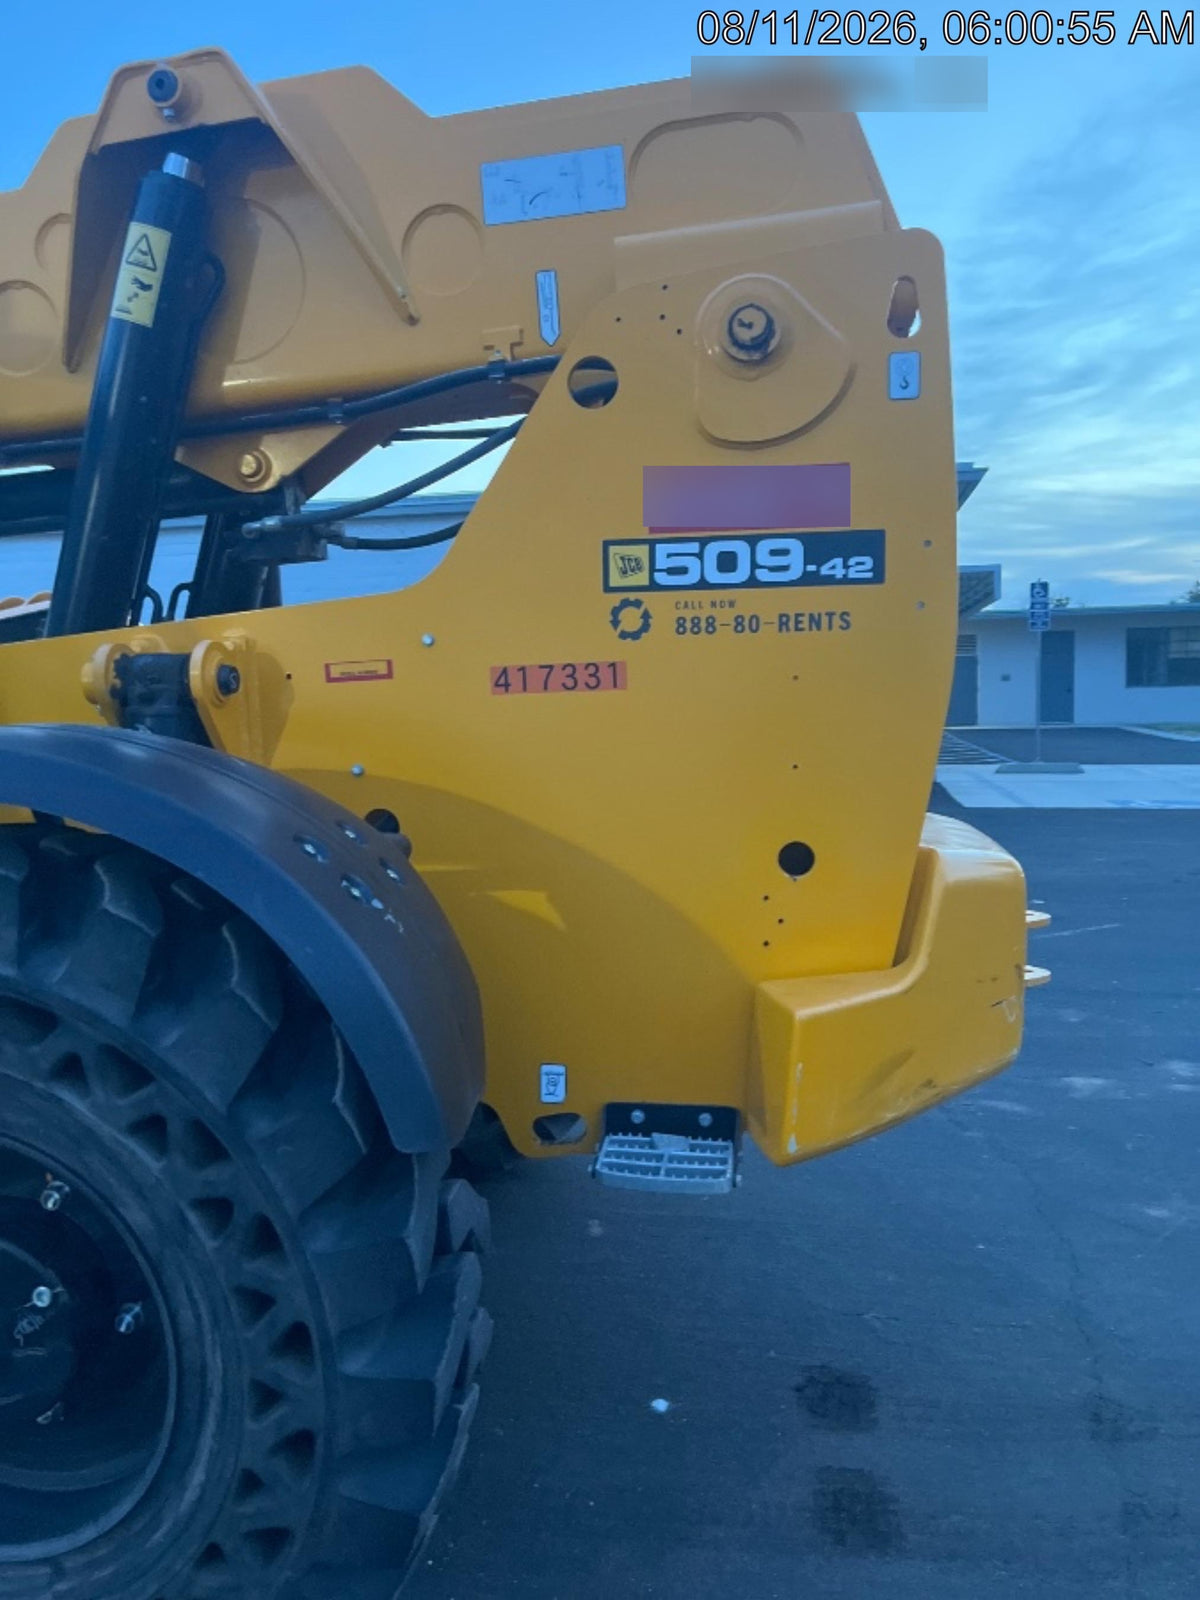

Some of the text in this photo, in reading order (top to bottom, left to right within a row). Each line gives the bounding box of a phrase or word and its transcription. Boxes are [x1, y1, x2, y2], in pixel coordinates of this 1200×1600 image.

[617, 554, 645, 577] JCB
[653, 538, 874, 586] 509-42
[675, 600, 737, 610] CALL NOW
[675, 611, 852, 635] 888-80-RENTS
[494, 662, 619, 692] 417331
